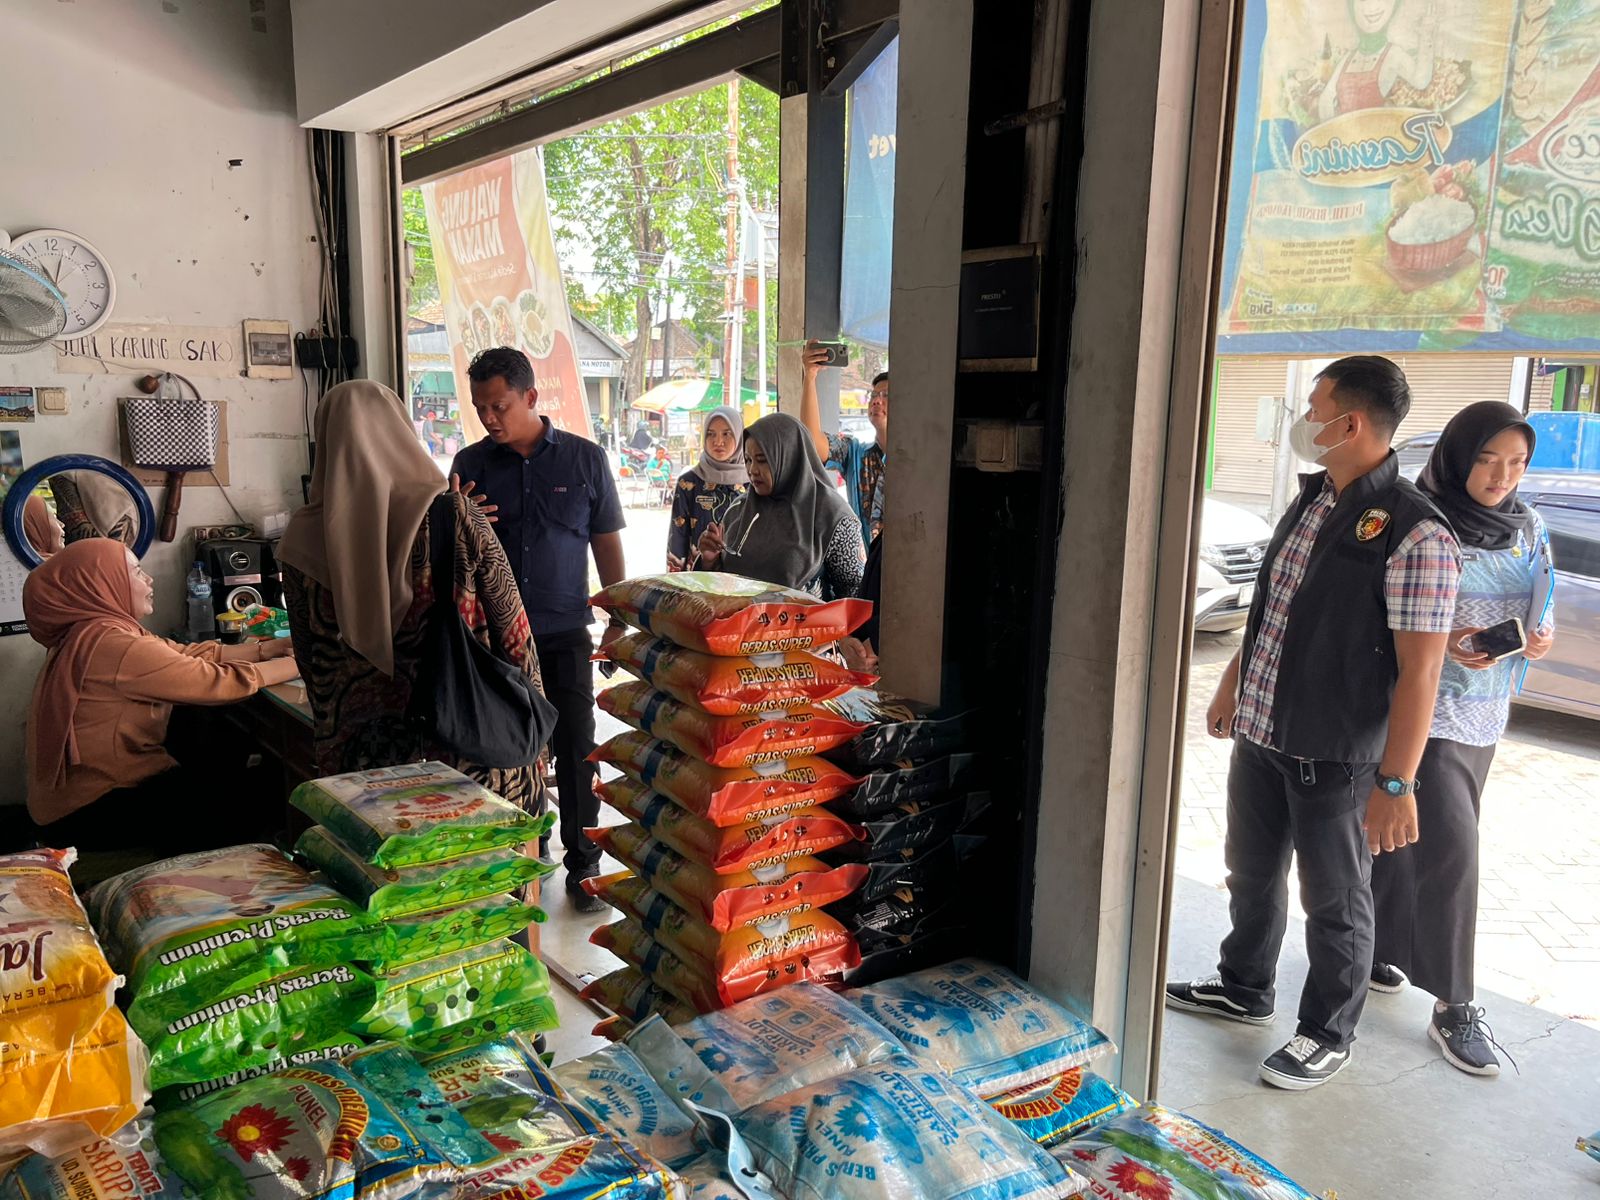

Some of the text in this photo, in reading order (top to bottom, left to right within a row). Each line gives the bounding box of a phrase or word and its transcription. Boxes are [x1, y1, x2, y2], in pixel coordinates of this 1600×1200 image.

[21, 243, 37, 257] 11
[44, 238, 58, 251] 12
[70, 245, 78, 257] 1
[84, 260, 96, 271] 2
[92, 281, 105, 290] 3
[90, 300, 102, 310] 4
[75, 314, 87, 326] 5
[111, 336, 169, 359] KARUNG
[180, 338, 233, 363] (SAK)
[740, 636, 813, 654] BERAS SUPER
[736, 663, 815, 685] BERAS SUPER
[743, 745, 815, 767] BERAS SUPER
[744, 798, 815, 822] BERAS SUPER
[159, 907, 351, 966] Beras Premium
[167, 965, 356, 1035] Beras Premium
[880, 1001, 915, 1029] PUNEL
[287, 1082, 329, 1130] PUNEL
[588, 1069, 658, 1137] BERAS PREMIUM
[600, 1084, 635, 1119] PUNEL
[874, 1070, 957, 1146] SARIPADI
[60, 1157, 80, 1175] UD.
[125, 1149, 164, 1195] TERATE
[463, 1152, 546, 1190] PUNEL
